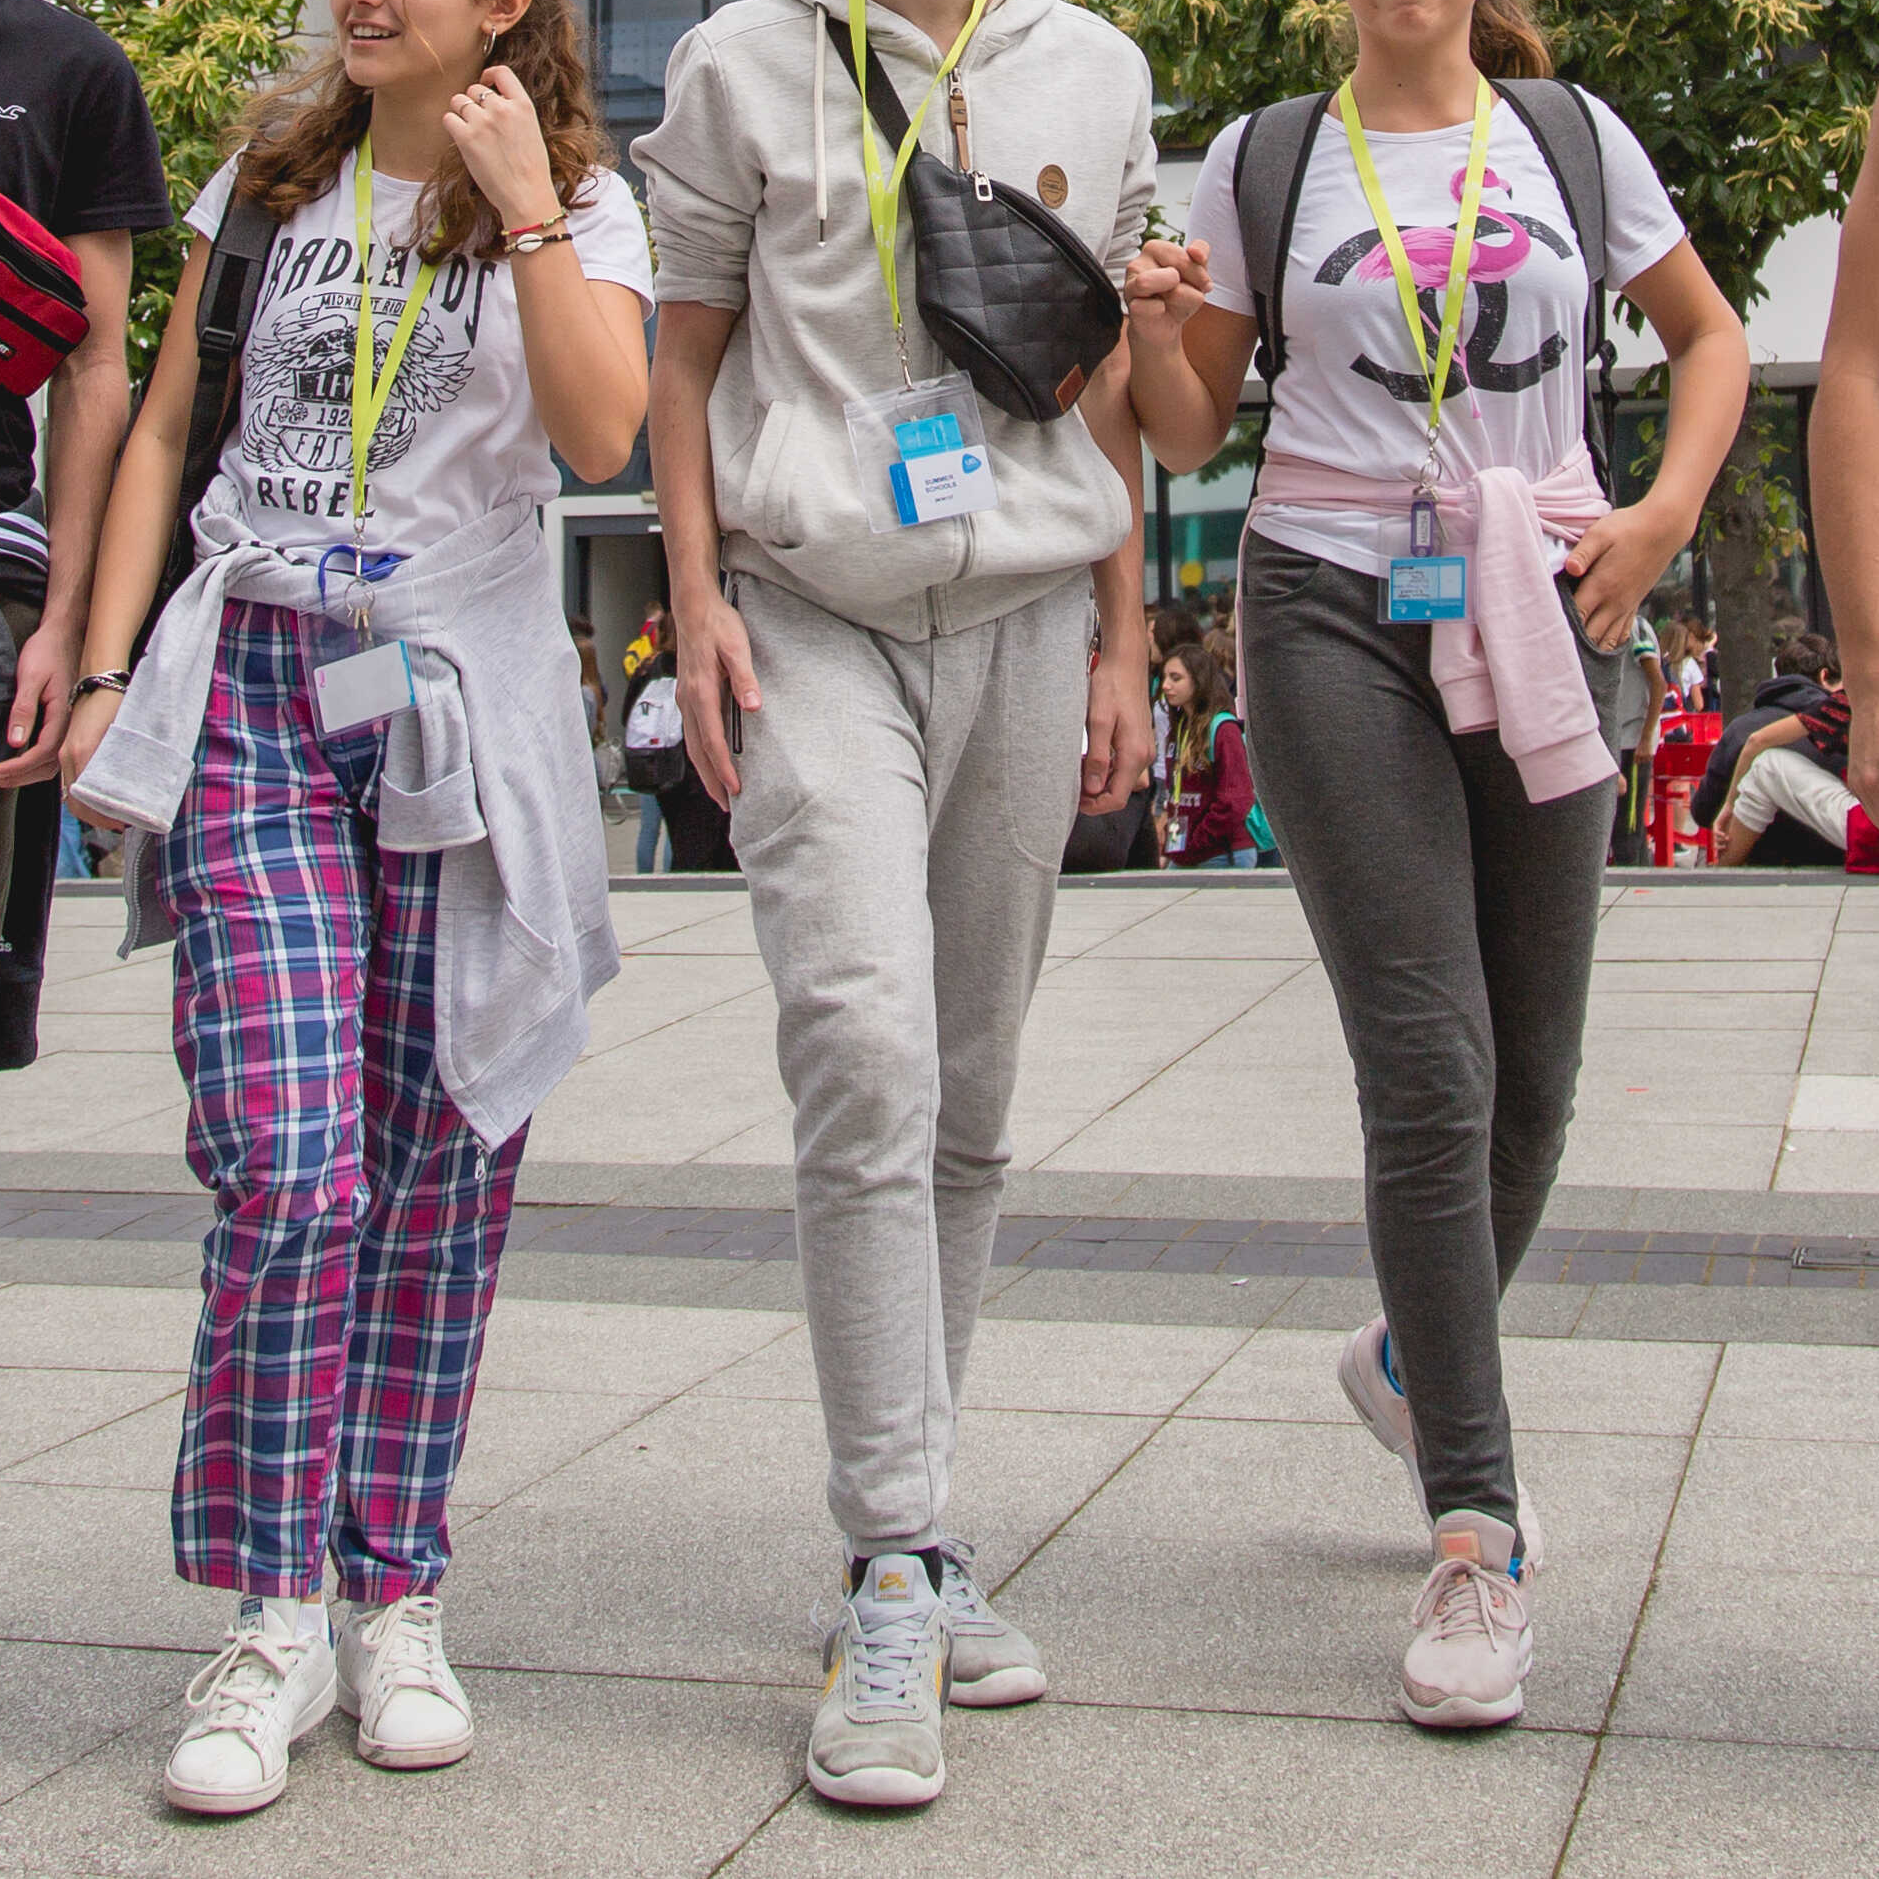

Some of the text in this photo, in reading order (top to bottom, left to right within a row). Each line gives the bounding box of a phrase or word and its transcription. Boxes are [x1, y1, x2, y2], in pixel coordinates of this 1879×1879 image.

[257, 236, 498, 350] BADLADS
[320, 294, 380, 311] MIDNIT
[294, 432, 354, 467] FAS
[257, 476, 377, 518] REBEL
